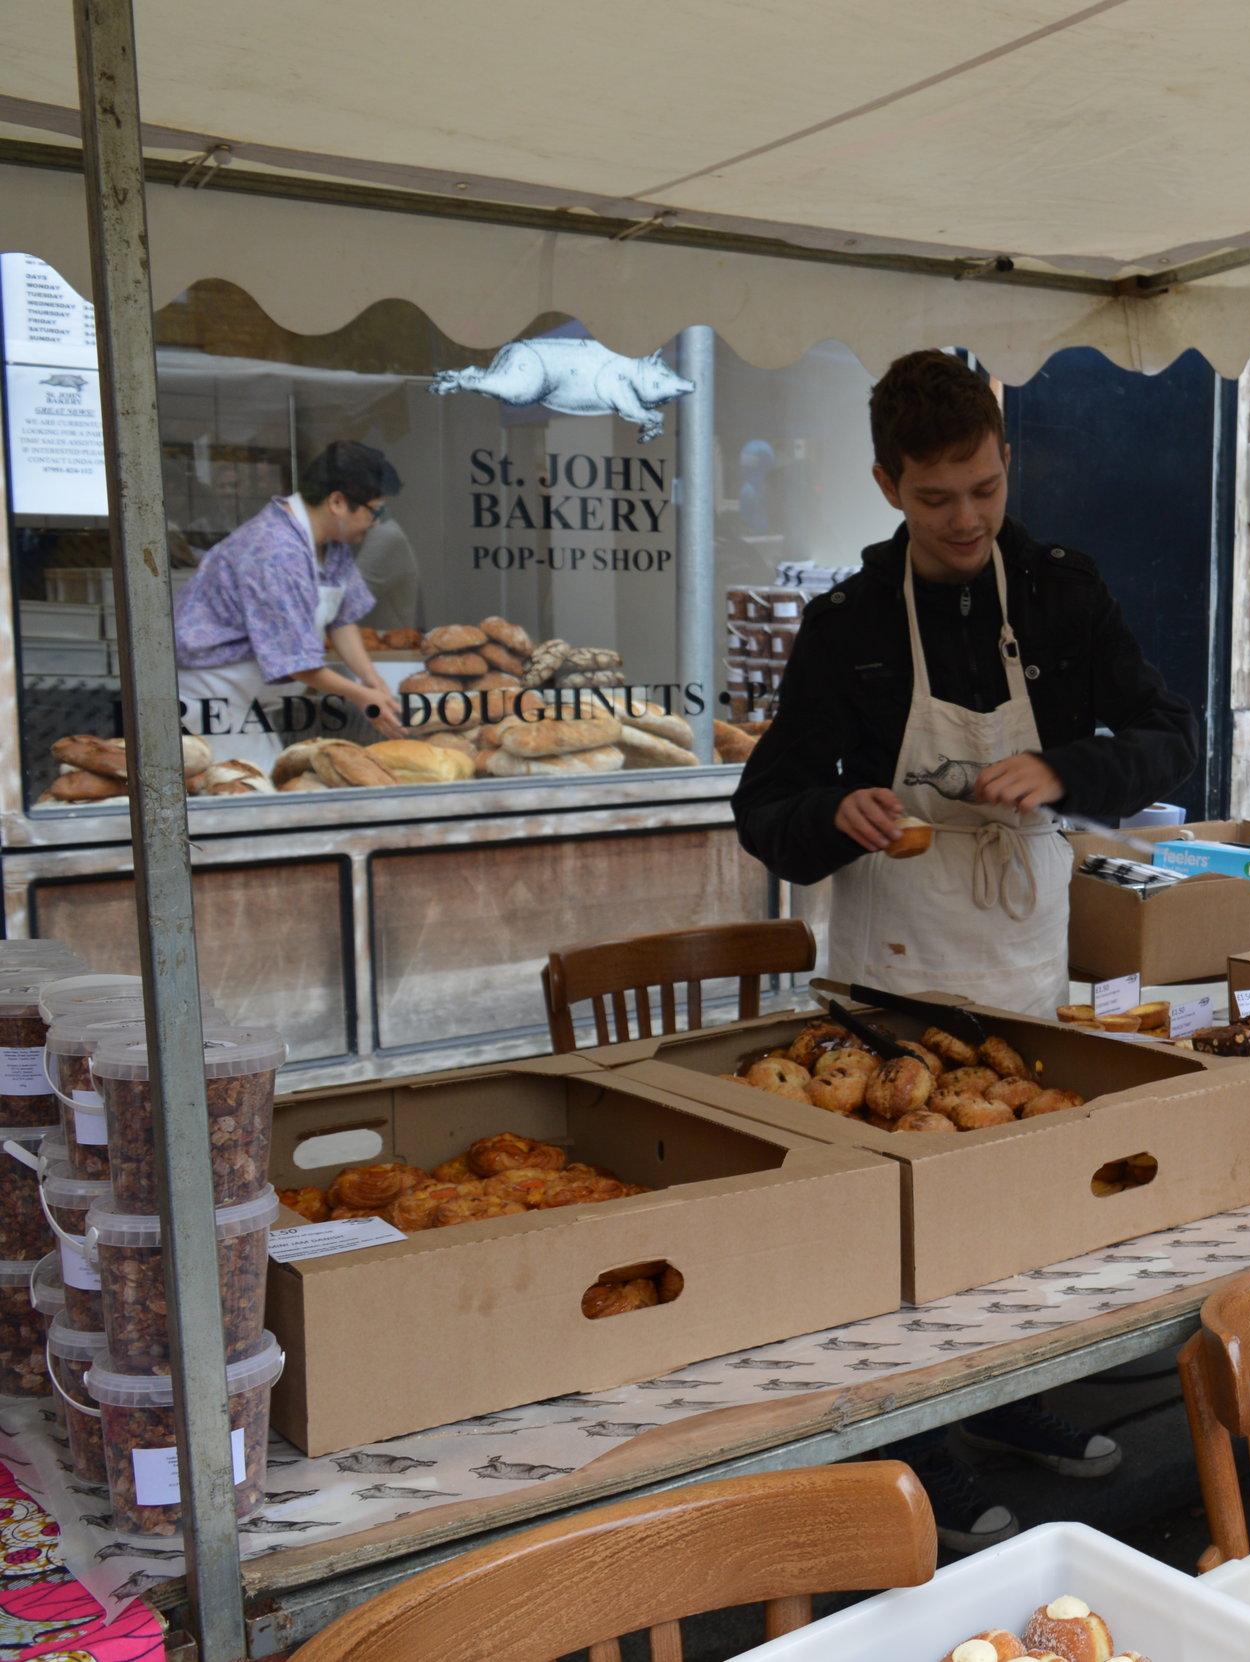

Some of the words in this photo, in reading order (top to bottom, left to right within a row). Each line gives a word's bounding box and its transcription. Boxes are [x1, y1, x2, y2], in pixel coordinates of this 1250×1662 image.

[470, 448, 525, 487] St.
[538, 453, 667, 492] JOHN
[470, 492, 669, 533] BAKERY
[472, 546, 587, 571] POP-UP
[592, 549, 672, 572] SHOP
[400, 681, 706, 729] DOUGHNUTS
[1162, 845, 1210, 867] feelers
